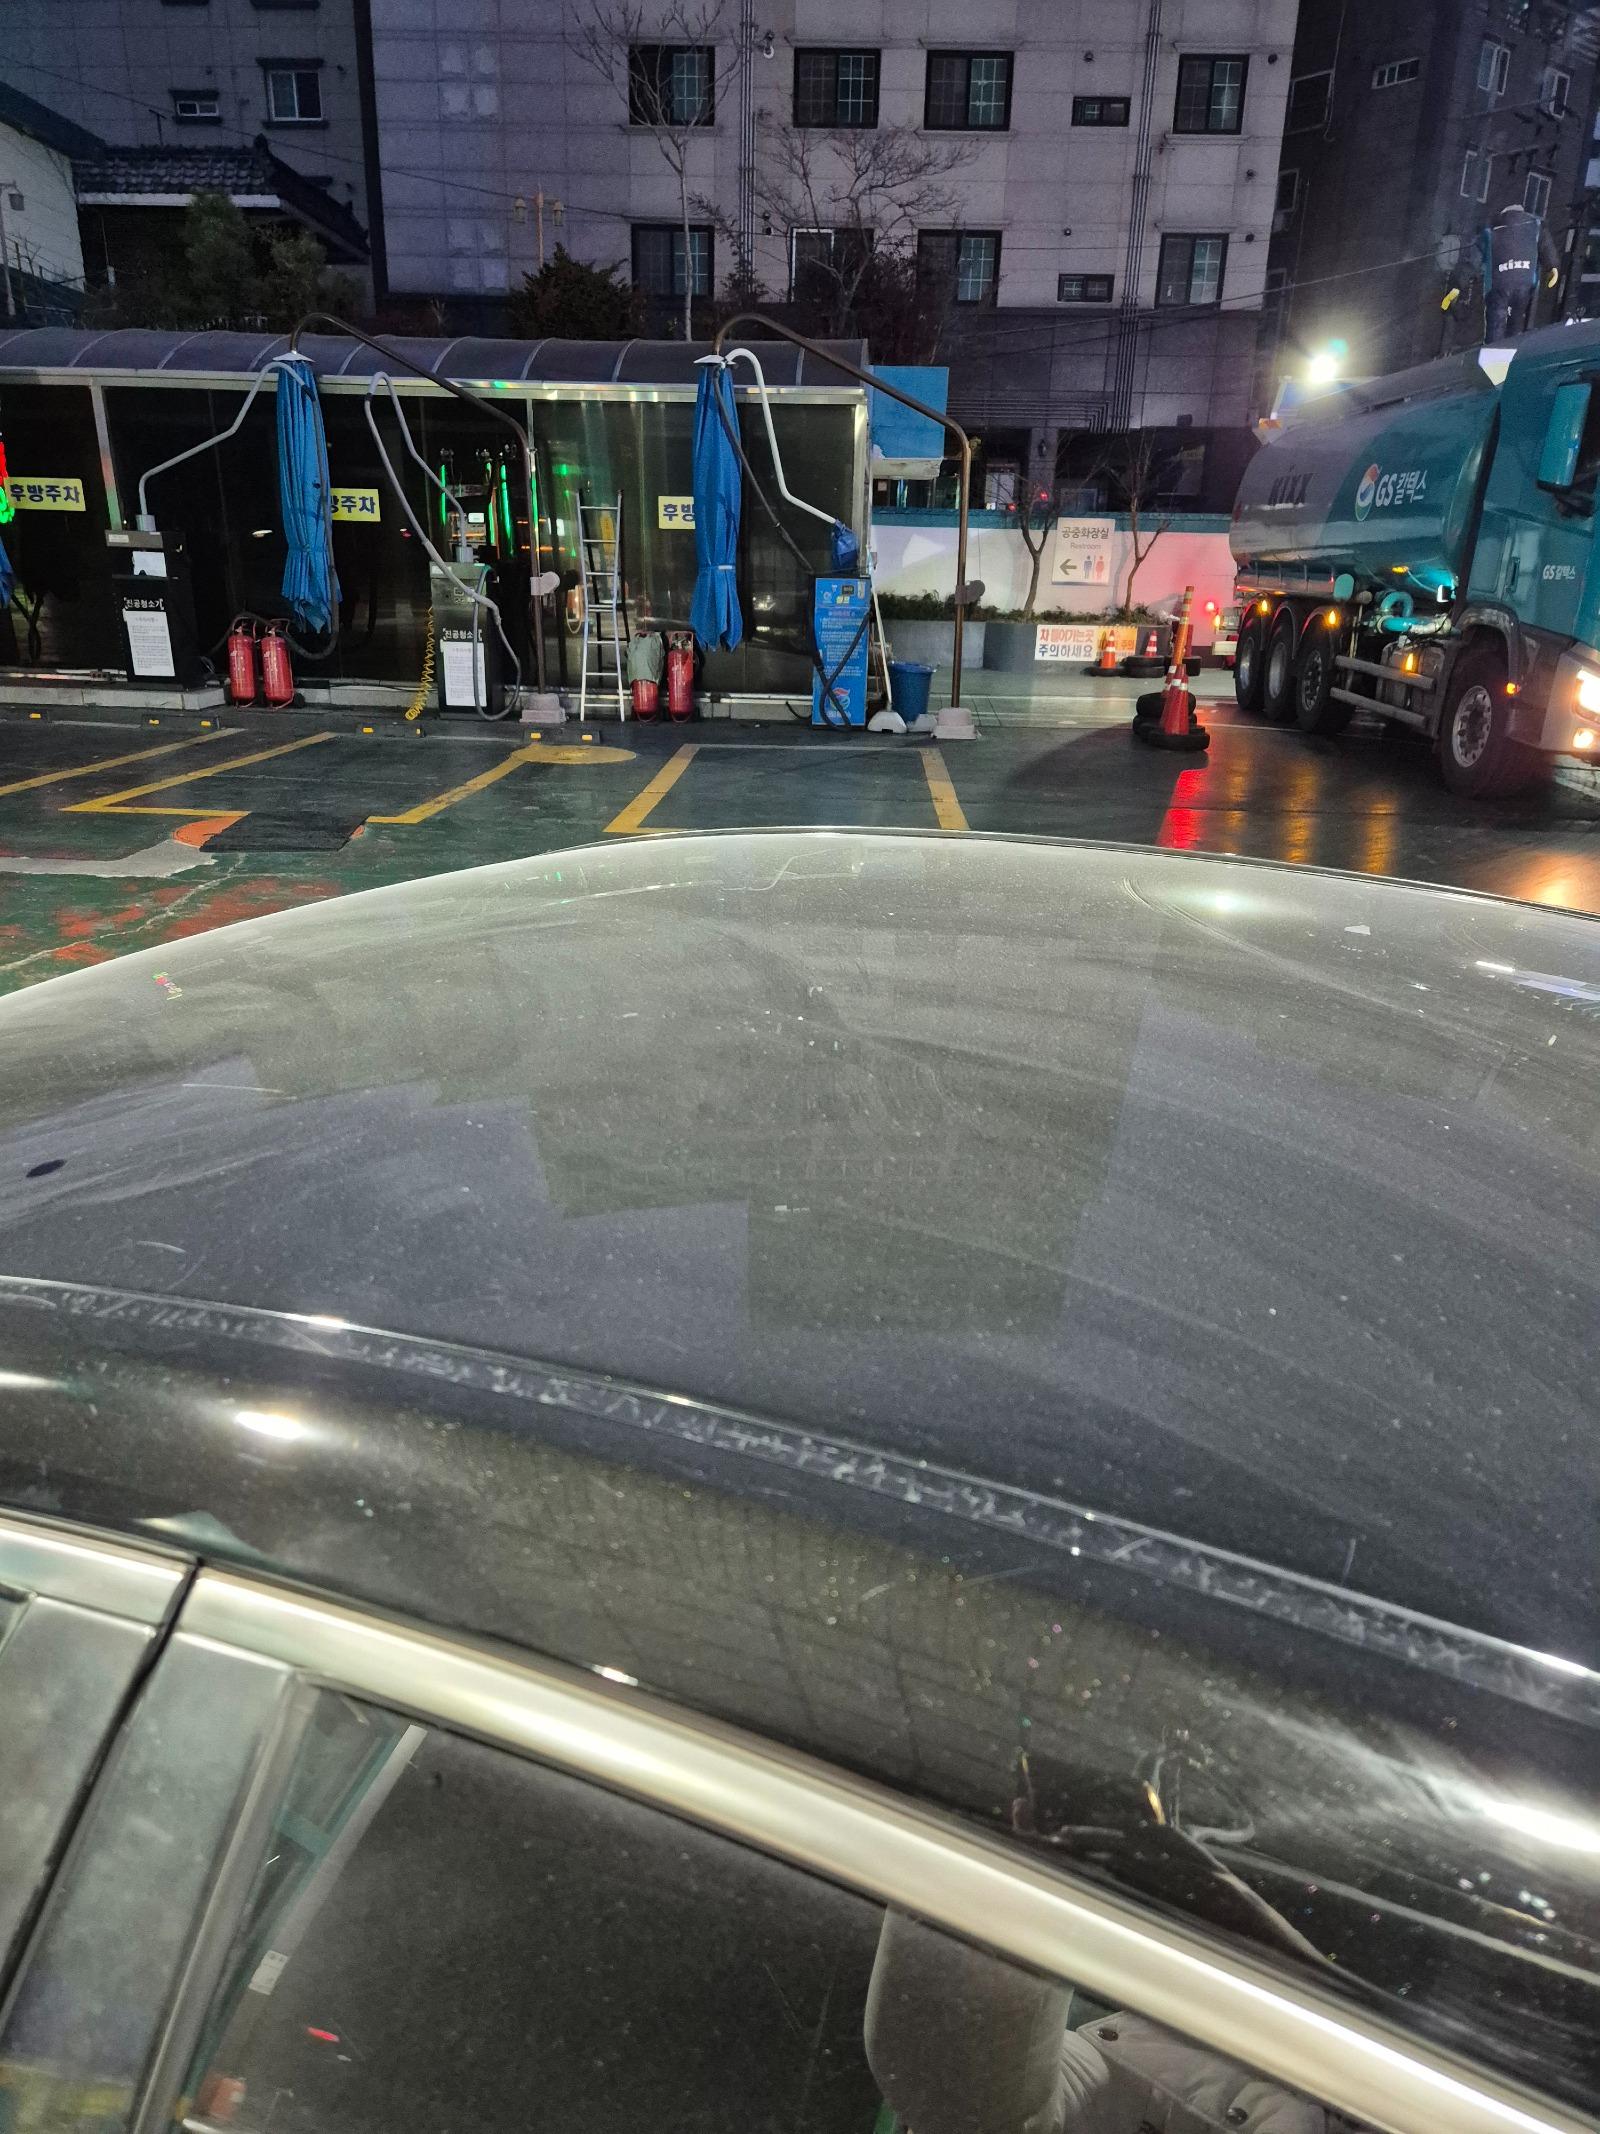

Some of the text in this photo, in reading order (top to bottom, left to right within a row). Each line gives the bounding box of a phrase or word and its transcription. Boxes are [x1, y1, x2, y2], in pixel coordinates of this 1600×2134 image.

[10, 484, 80, 503] 후방주차
[1376, 470, 1427, 507] GS 칼텍스
[663, 504, 695, 522] 후방
[1062, 526, 1109, 539] 공중화장실
[1543, 565, 1555, 580] GS
[1040, 628, 1050, 642] 차
[1039, 644, 1093, 658] 주의하세요
